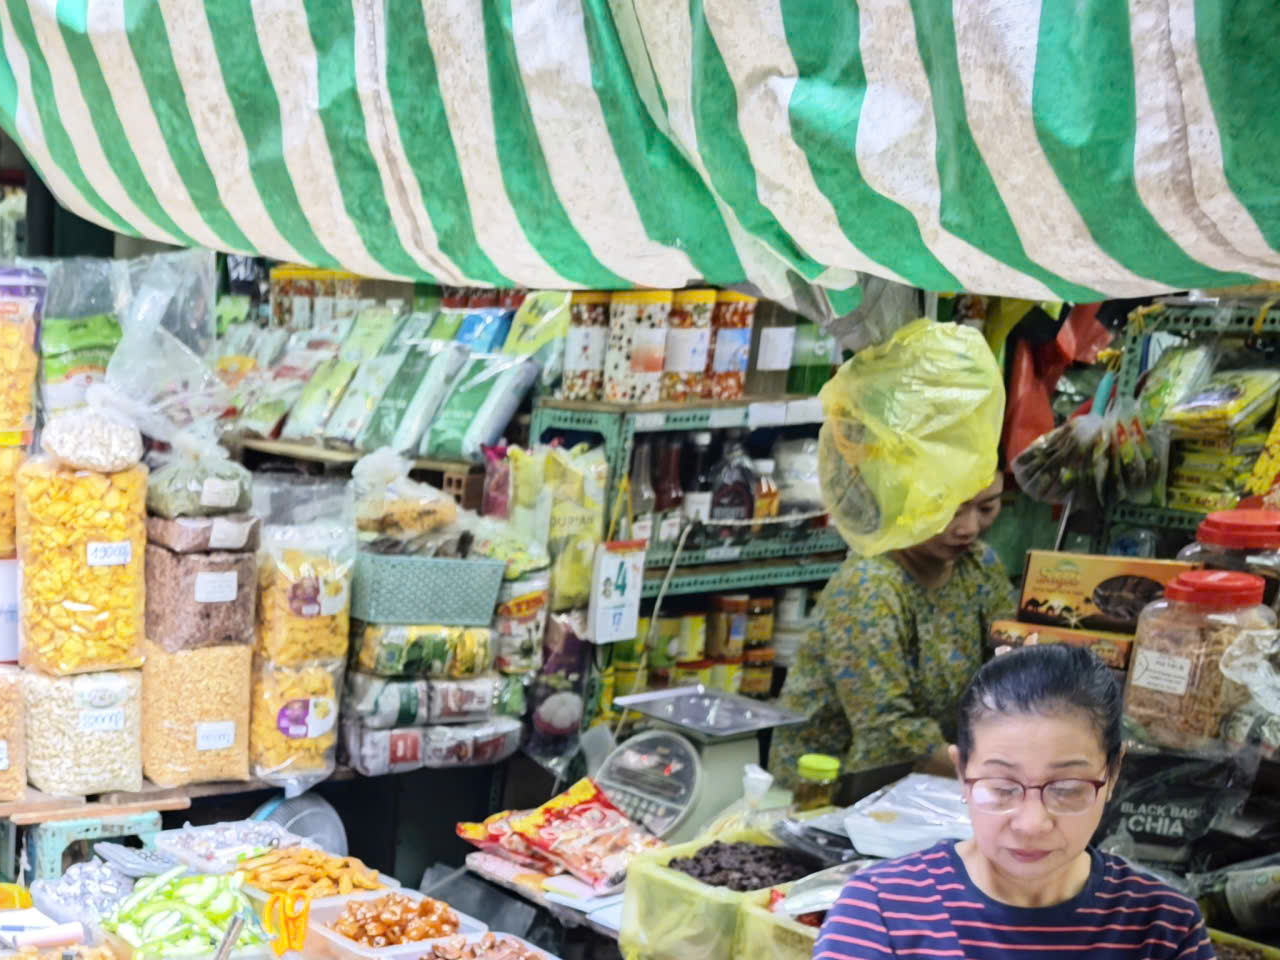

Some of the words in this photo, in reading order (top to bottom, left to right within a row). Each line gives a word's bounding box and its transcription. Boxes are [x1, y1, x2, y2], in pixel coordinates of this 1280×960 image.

[614, 560, 627, 597] 4
[1120, 801, 1166, 817] BLACK
[1128, 815, 1184, 836] CHIA
